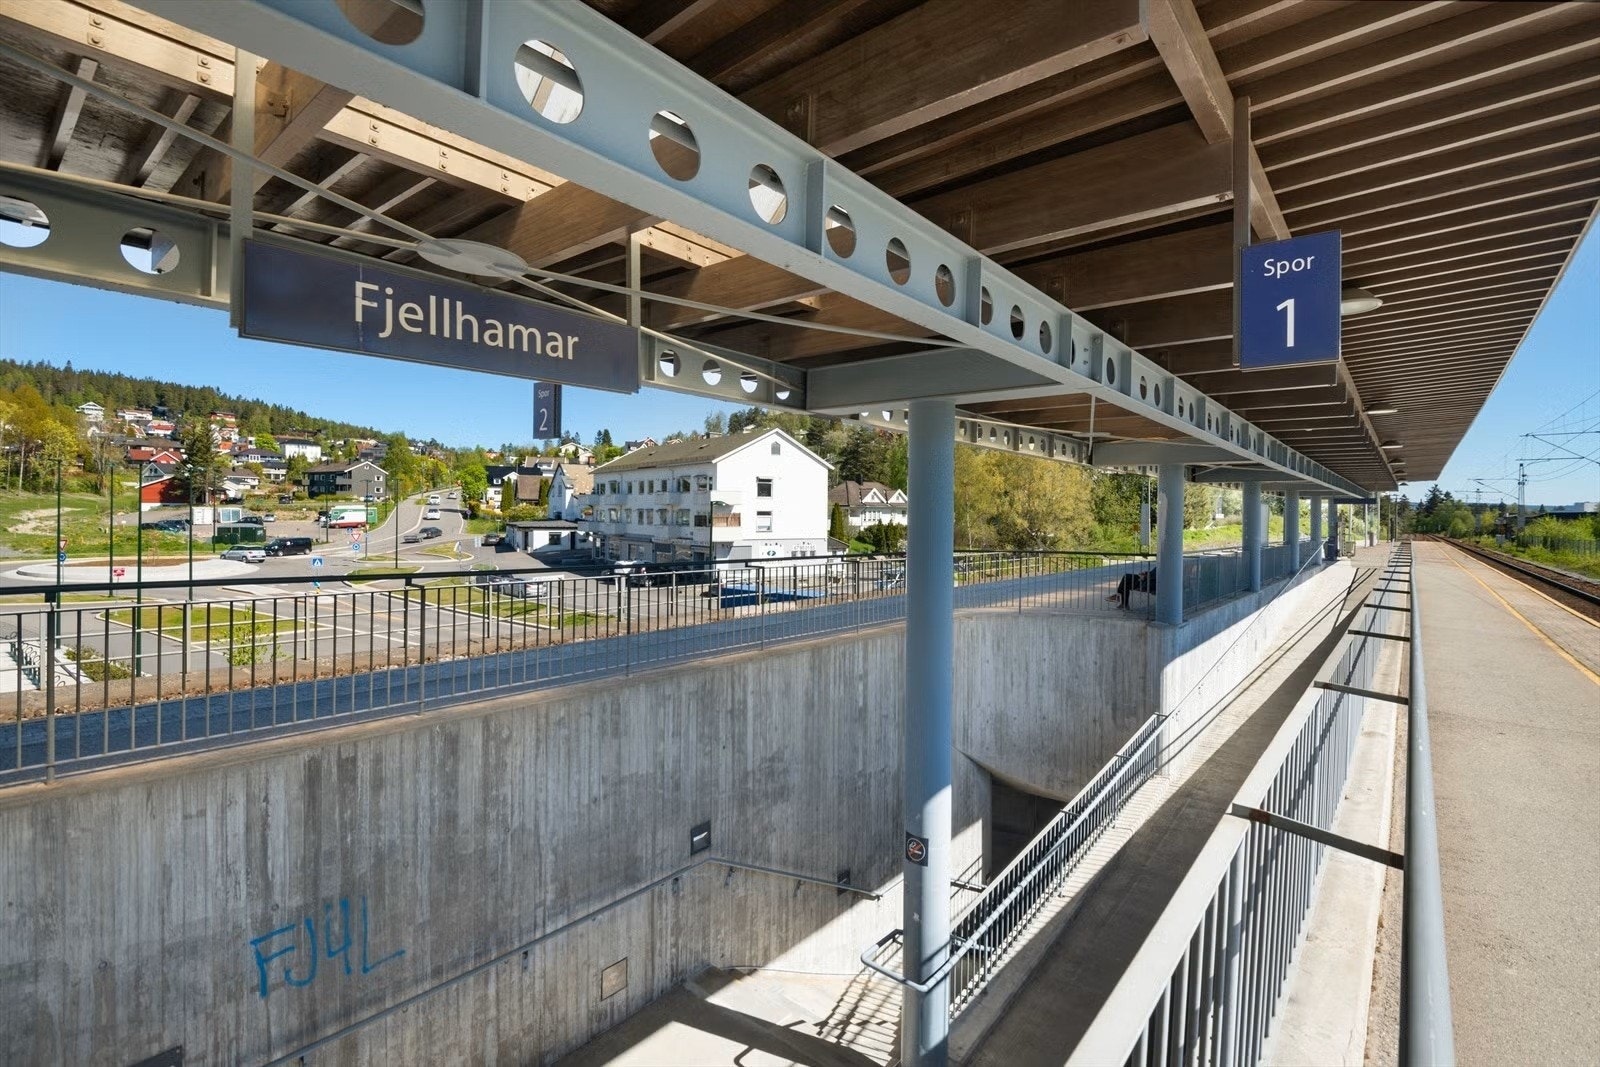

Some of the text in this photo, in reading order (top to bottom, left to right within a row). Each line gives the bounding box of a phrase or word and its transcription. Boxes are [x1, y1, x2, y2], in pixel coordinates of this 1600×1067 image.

[1264, 255, 1315, 278] Spor
[354, 280, 579, 361] Fjellhamar
[1276, 298, 1294, 347] 1
[538, 389, 550, 400] Spor
[539, 408, 548, 431] 2
